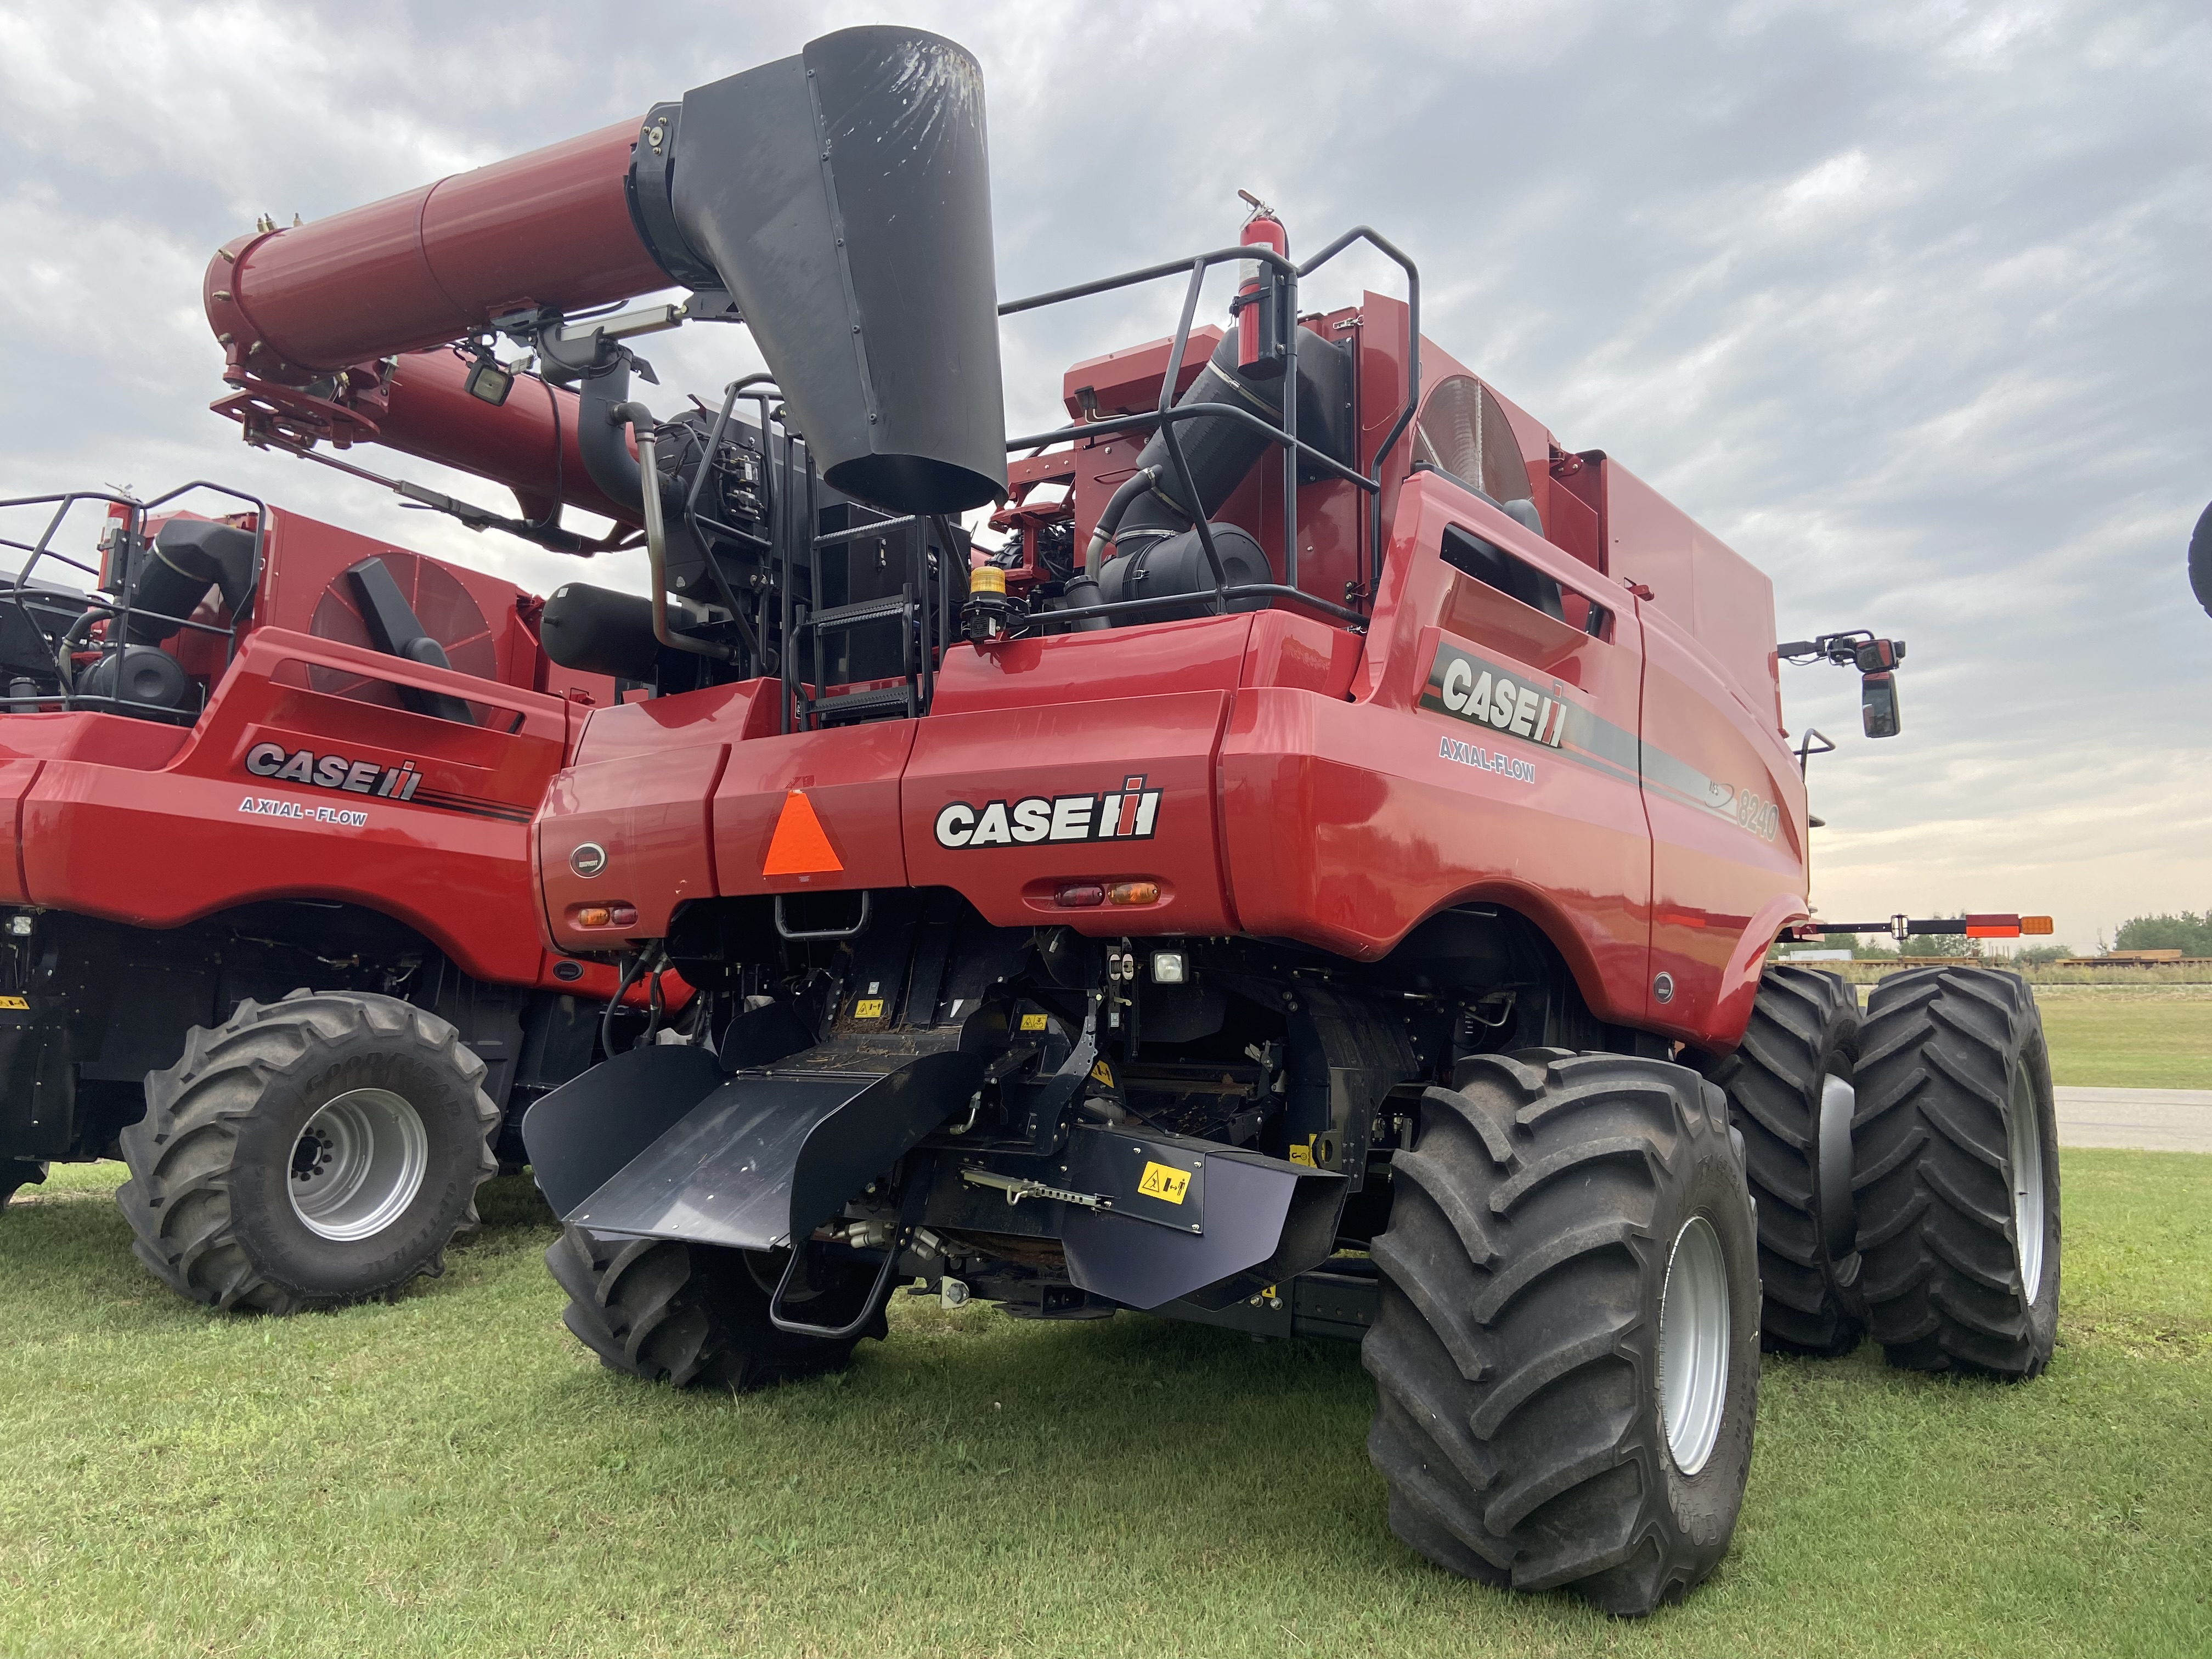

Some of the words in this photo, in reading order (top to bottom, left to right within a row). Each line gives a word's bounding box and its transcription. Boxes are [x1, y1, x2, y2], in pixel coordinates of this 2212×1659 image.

[1442, 658, 1539, 737] CASE
[246, 742, 382, 793] CASE
[1440, 737, 1534, 783] AXIAL-FLOW
[936, 797, 1094, 847] CASE
[1739, 789, 1779, 842] 8240
